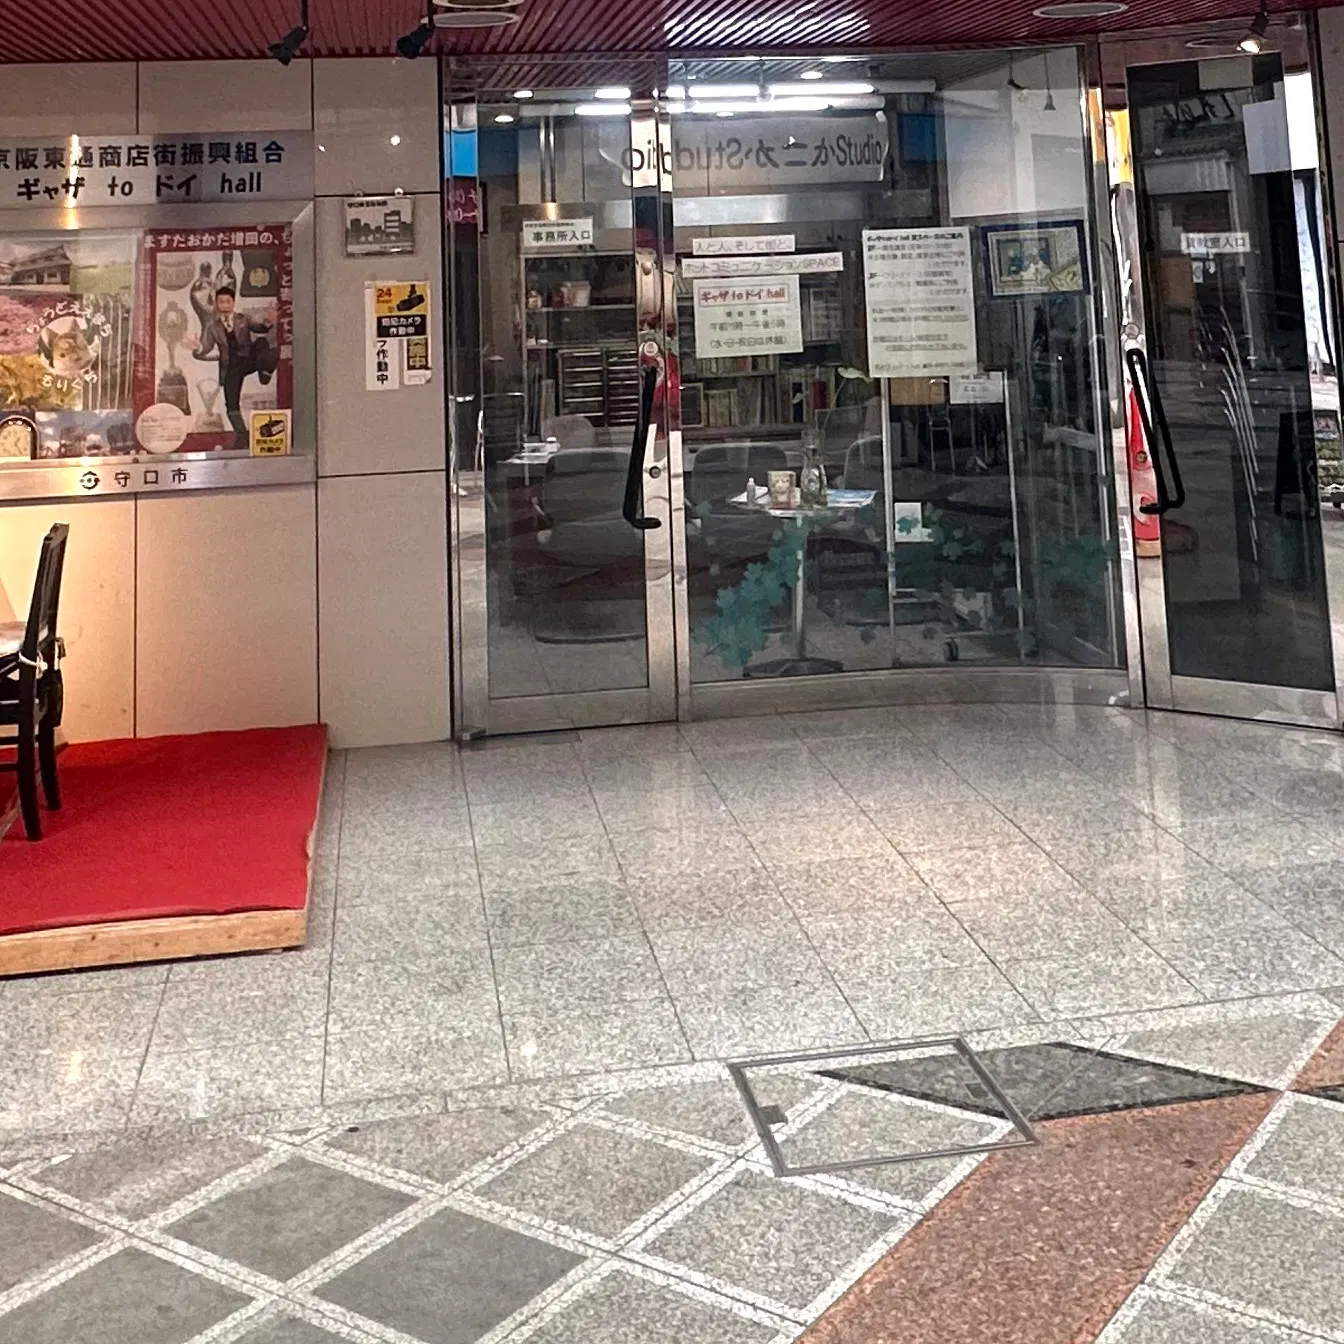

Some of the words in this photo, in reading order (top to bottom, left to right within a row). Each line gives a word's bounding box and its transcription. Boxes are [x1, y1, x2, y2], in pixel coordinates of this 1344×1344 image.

[108, 175, 134, 197] to
[155, 173, 199, 198] ドイ
[219, 171, 263, 195] hall
[532, 229, 592, 243] 事務所入口
[376, 287, 393, 299] 24
[114, 468, 189, 488] 守口市
